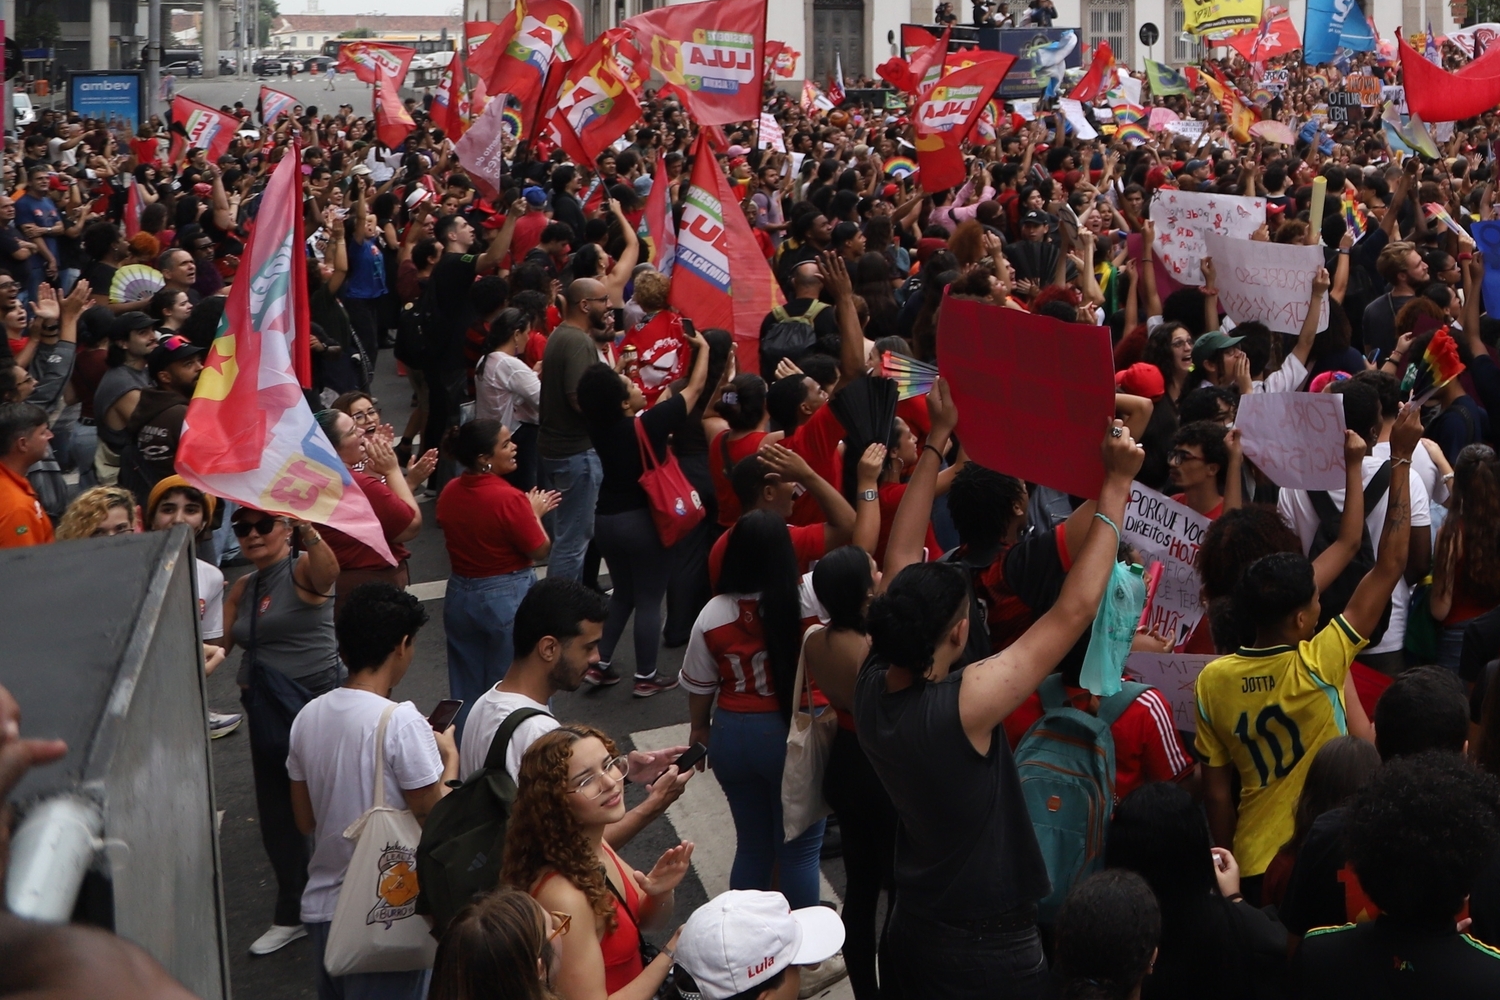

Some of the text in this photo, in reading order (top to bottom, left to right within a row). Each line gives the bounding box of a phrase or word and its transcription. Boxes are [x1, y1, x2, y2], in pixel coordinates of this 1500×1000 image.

[80, 80, 131, 91] ambev
[1338, 92, 1361, 106] FILHO
[681, 249, 730, 285] ALCKMIN
[1127, 490, 1206, 546] PORQUE VOC
[1125, 515, 1200, 566] DIREITOS HOJ
[1242, 675, 1276, 693] JOTTA
[1234, 704, 1306, 788] 10
[747, 955, 776, 979] Lula
